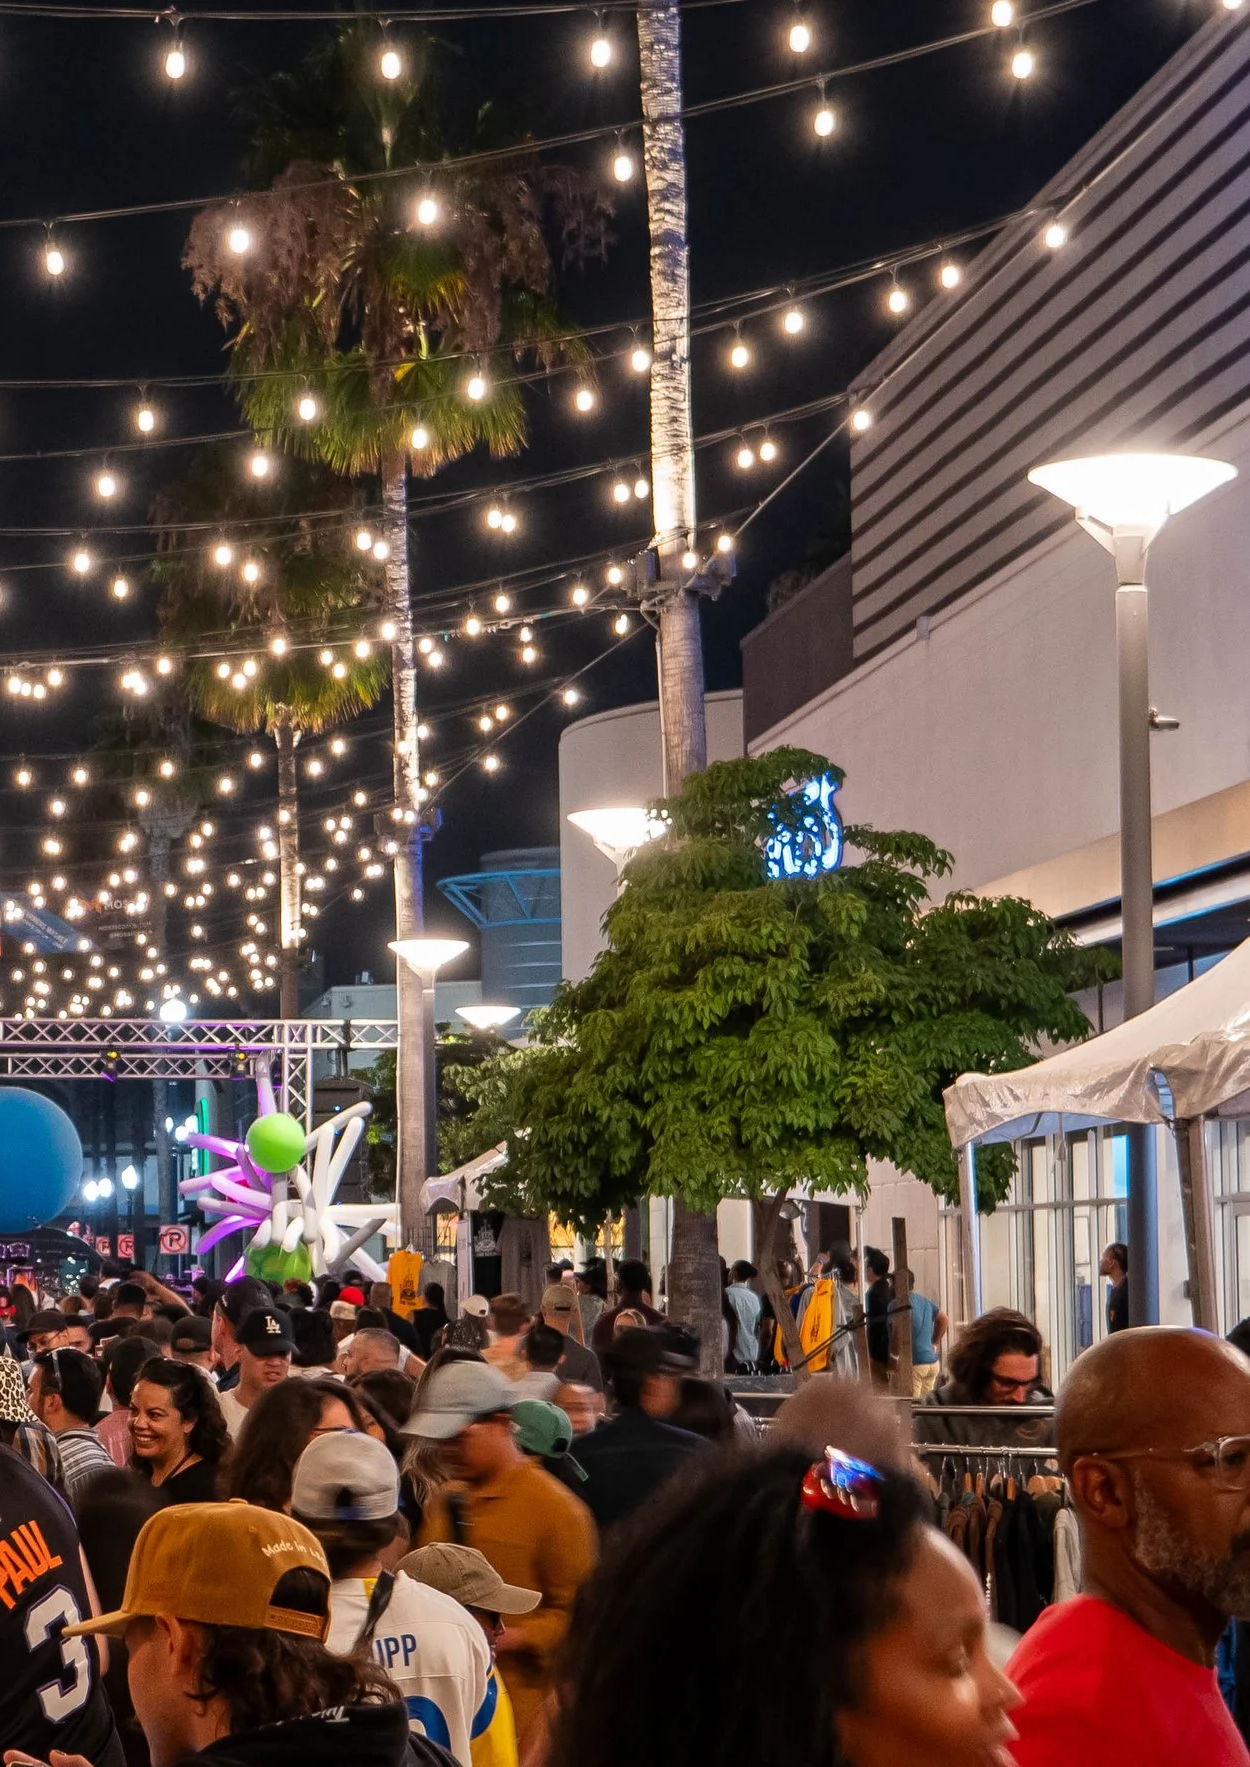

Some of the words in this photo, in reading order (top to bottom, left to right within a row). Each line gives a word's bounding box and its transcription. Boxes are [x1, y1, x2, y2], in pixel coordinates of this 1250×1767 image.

[265, 1315, 281, 1334] LA
[261, 1539, 294, 1558] Made
[293, 1540, 307, 1553] In
[23, 1584, 91, 1724] 3
